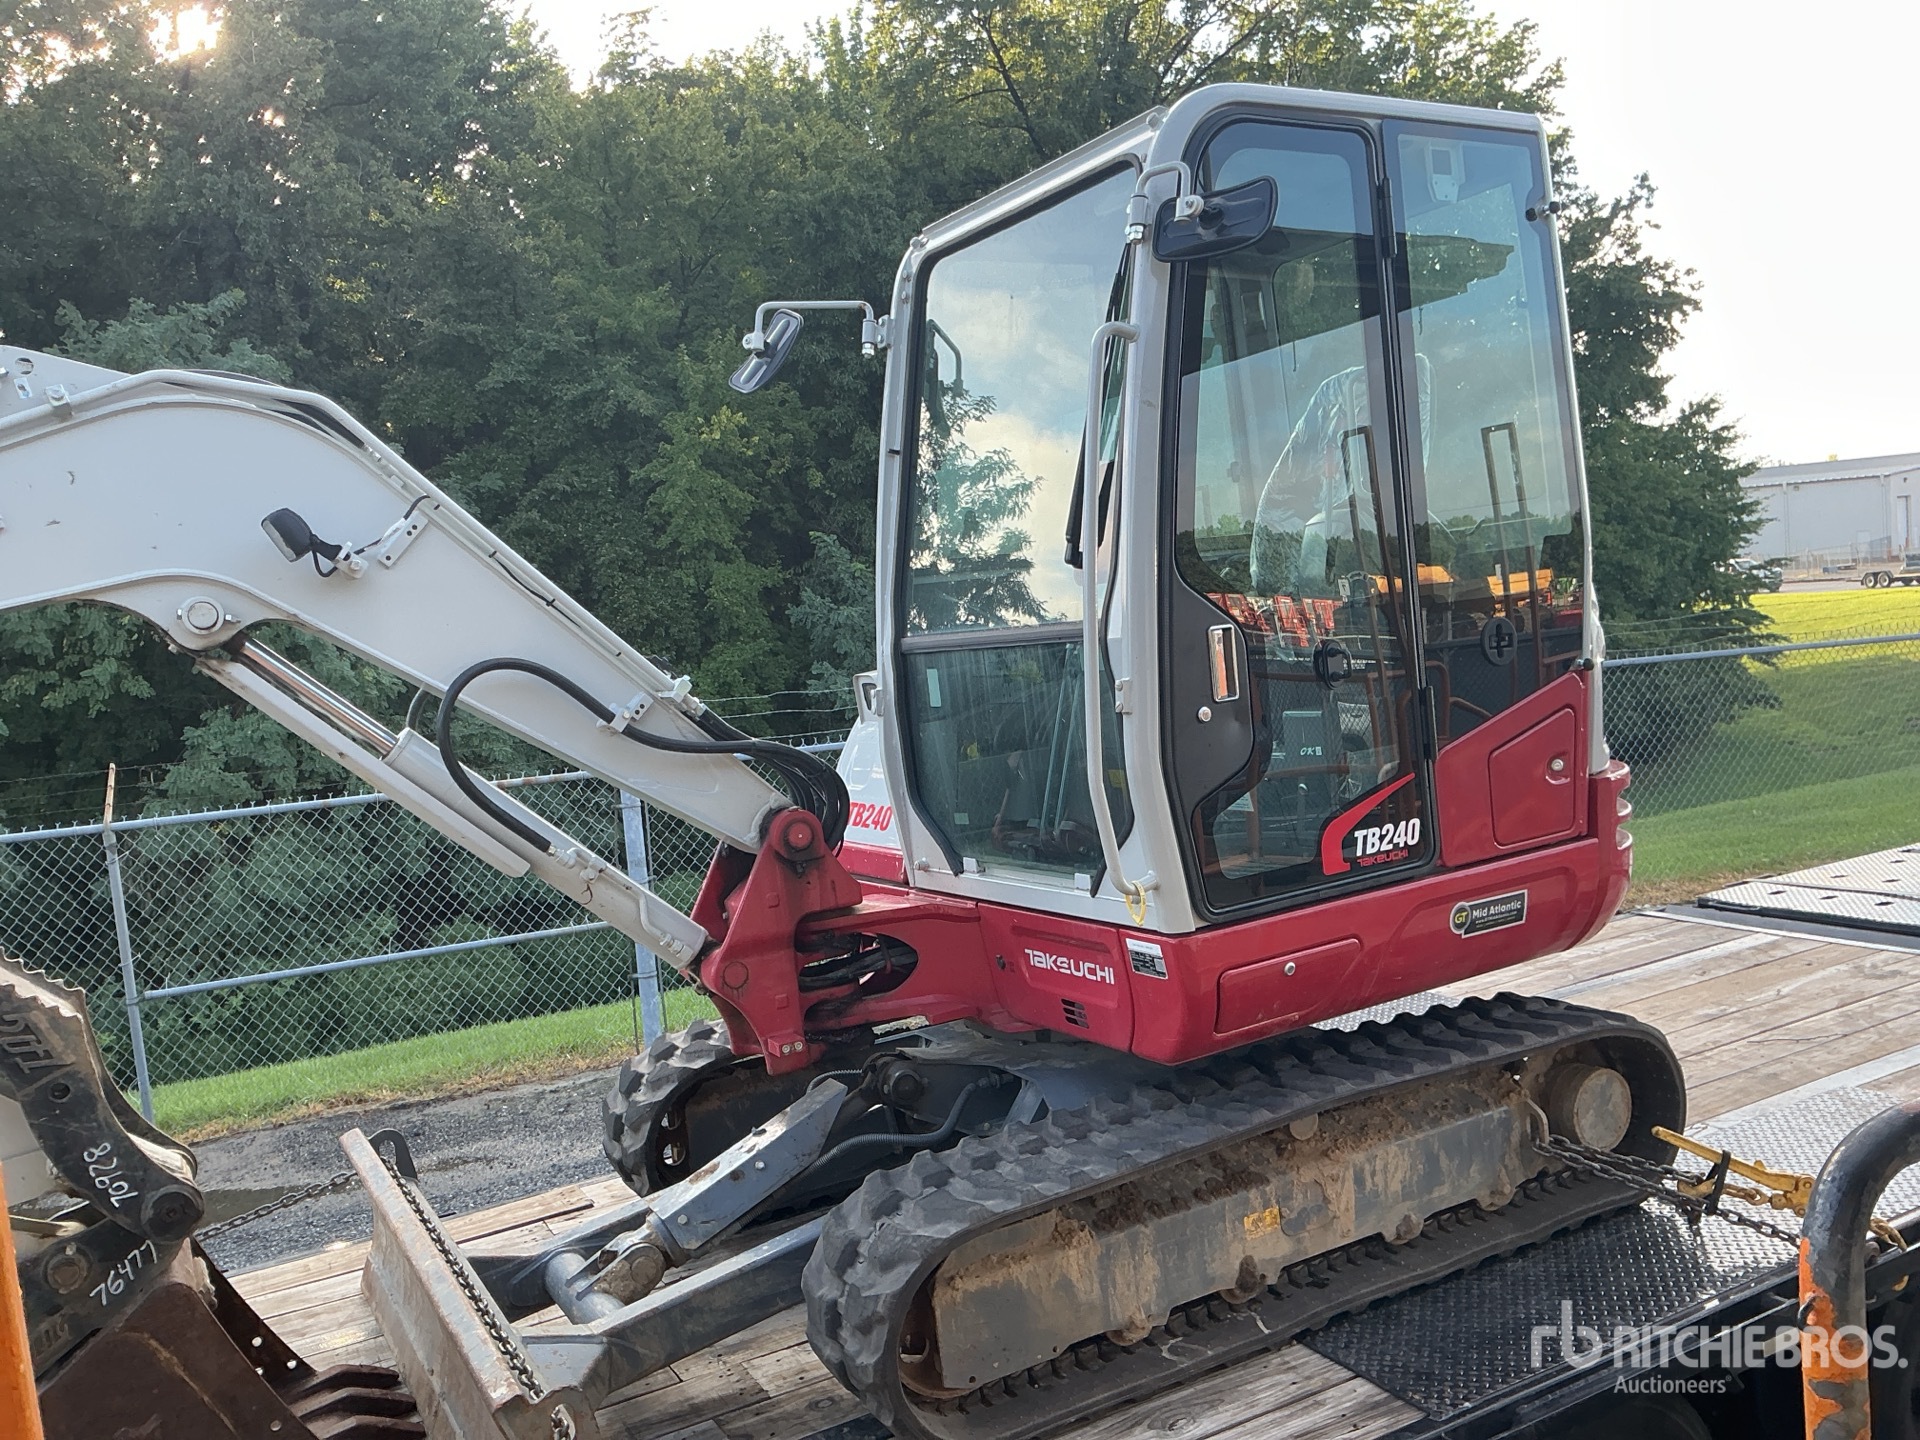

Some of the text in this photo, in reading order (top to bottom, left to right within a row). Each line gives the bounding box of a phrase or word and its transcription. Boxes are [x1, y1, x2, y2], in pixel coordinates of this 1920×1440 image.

[1353, 817, 1421, 857] TB240
[1357, 848, 1409, 867] TAKEUCHI
[1454, 911, 1468, 924] GT
[1472, 906, 1489, 920] Mid
[1489, 899, 1522, 915] Atlantic
[1024, 948, 1115, 985] TAKEUCHI
[89, 1239, 158, 1307] 76477
